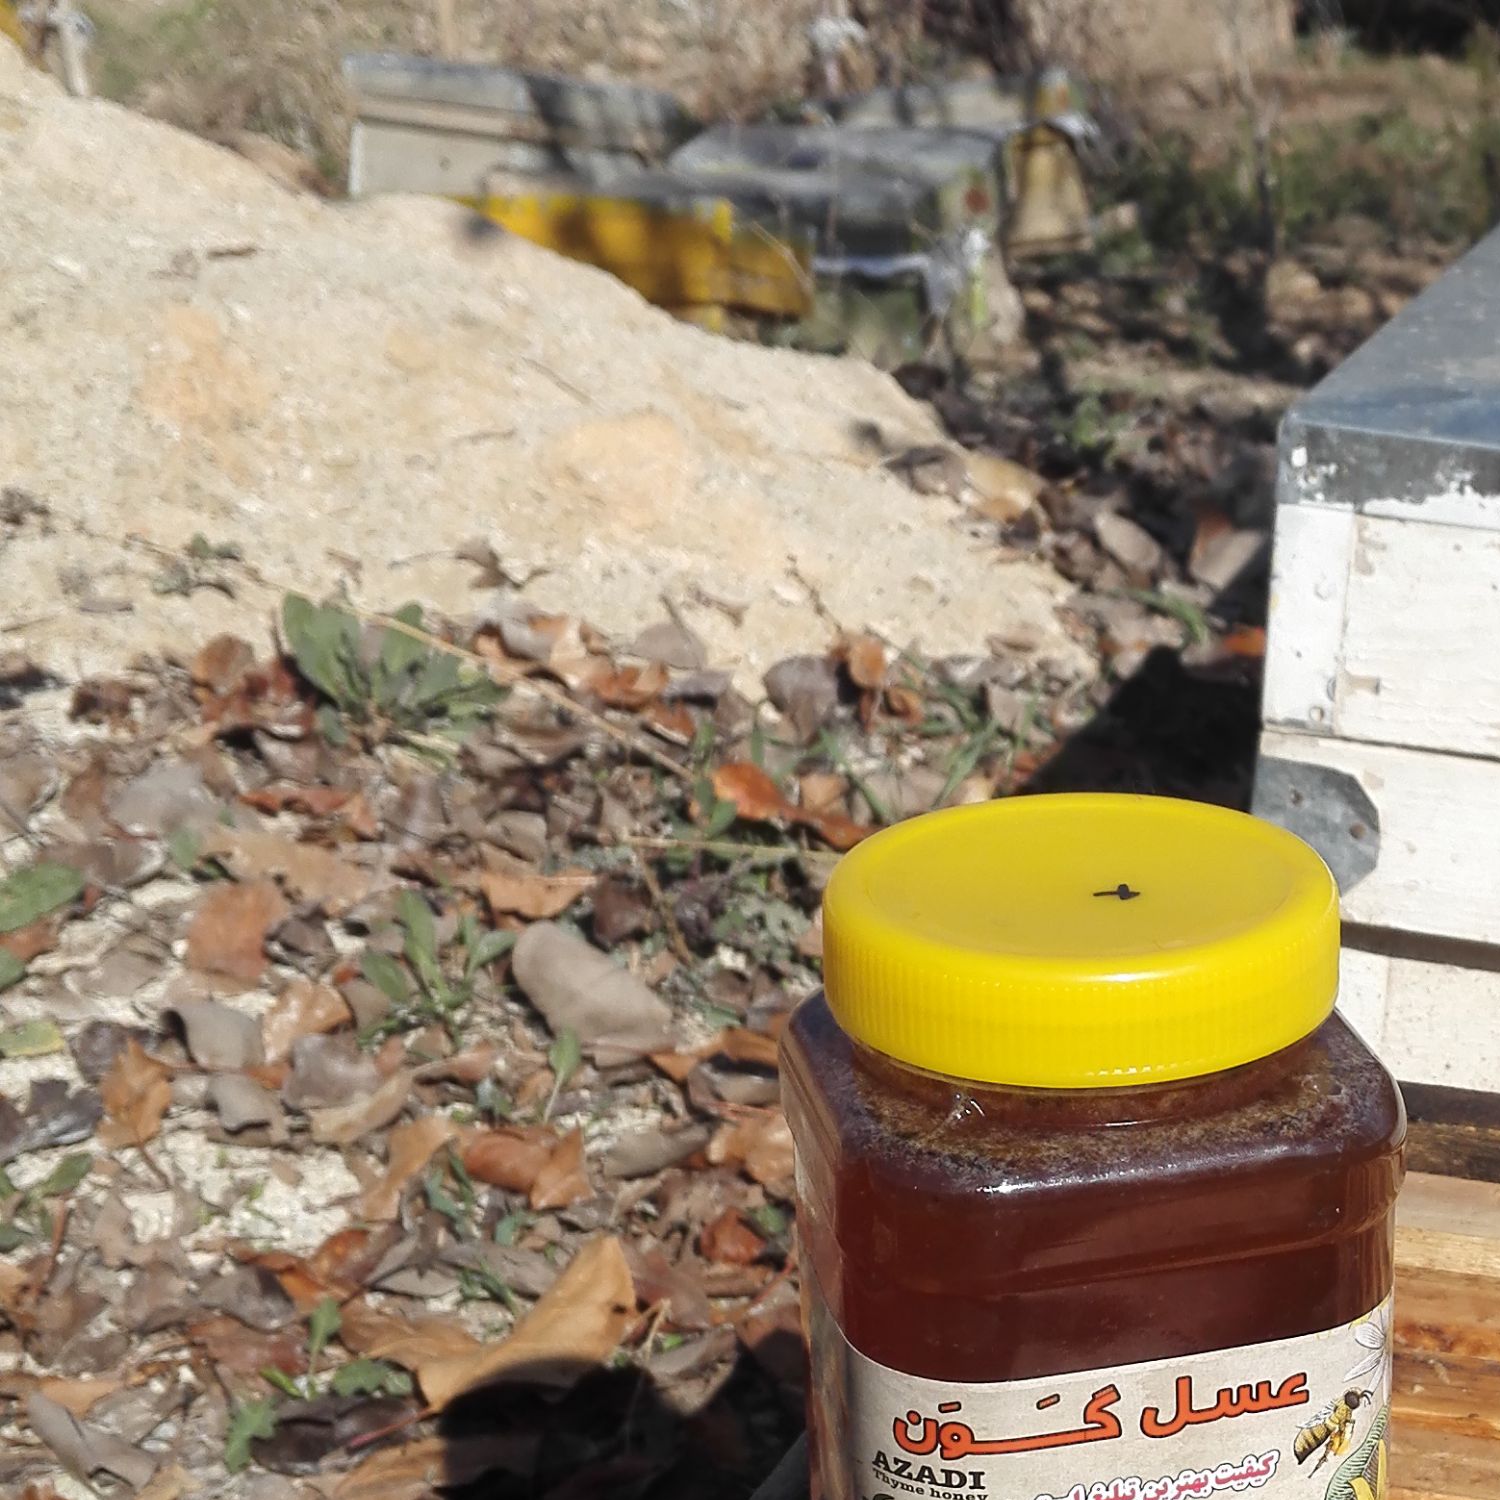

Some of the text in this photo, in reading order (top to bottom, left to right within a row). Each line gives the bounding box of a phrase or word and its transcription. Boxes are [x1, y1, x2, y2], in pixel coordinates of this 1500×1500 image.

[1139, 1372, 1310, 1439] عسل
[872, 1450, 985, 1489] AZADI
[872, 1467, 925, 1495] Thyme
[1214, 1455, 1275, 1487] کیفیت
